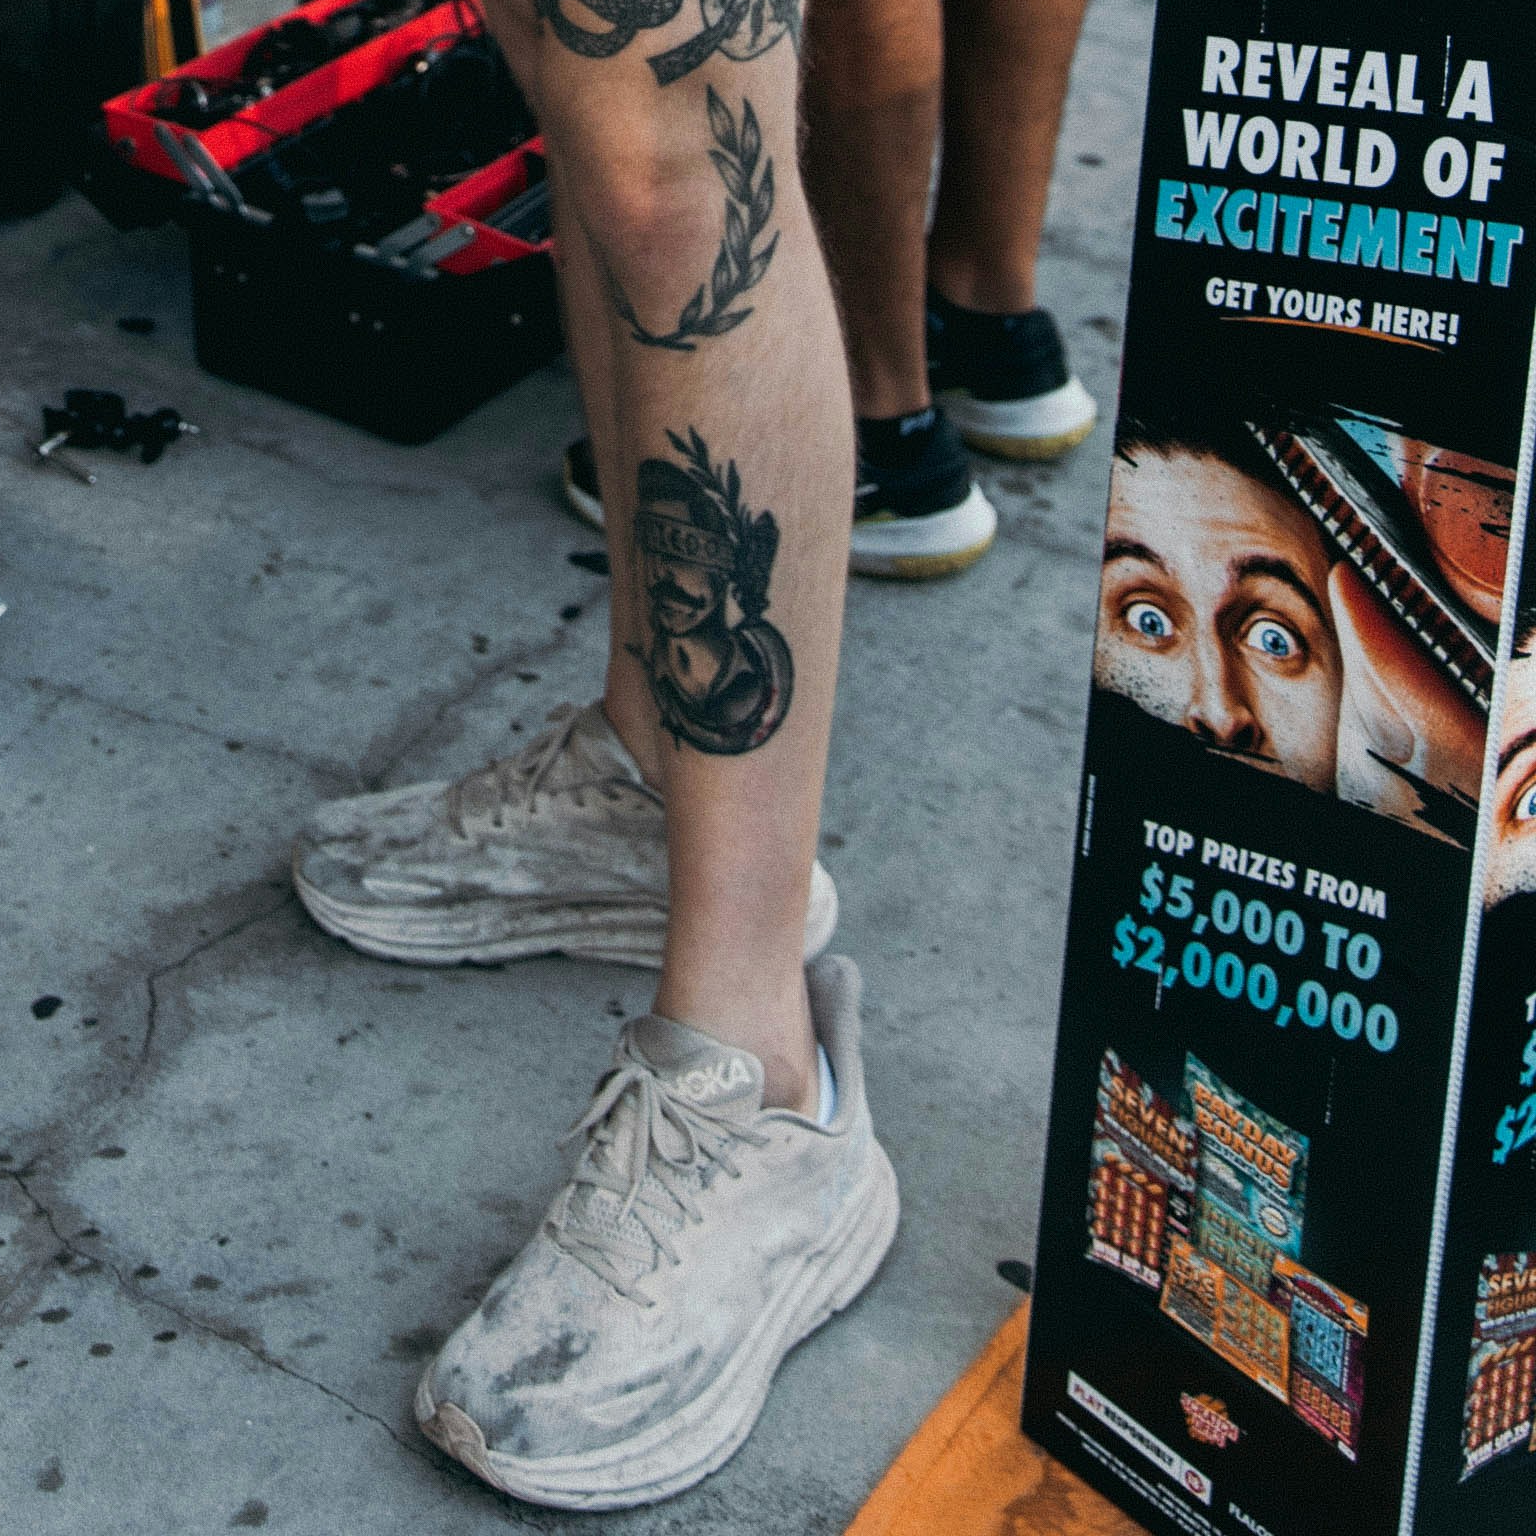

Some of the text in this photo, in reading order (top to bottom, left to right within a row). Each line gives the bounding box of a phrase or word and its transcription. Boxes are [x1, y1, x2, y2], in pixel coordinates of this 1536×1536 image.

[1201, 35, 1494, 123] REVEAL A
[1182, 108, 1506, 203] WORLD OF
[1154, 178, 1525, 288] EXCITEMENT
[1205, 277, 1460, 345] GET YOURS HERE!
[1143, 818, 1387, 919] TOP PRIZES FROM
[1139, 861, 1382, 981] $5,000 TO
[1112, 913, 1399, 1053] $2,000,000
[1110, 1075, 1187, 1154] SEVEN
[1193, 1079, 1298, 1168] PAYDAY
[1194, 1104, 1292, 1189] BONUS
